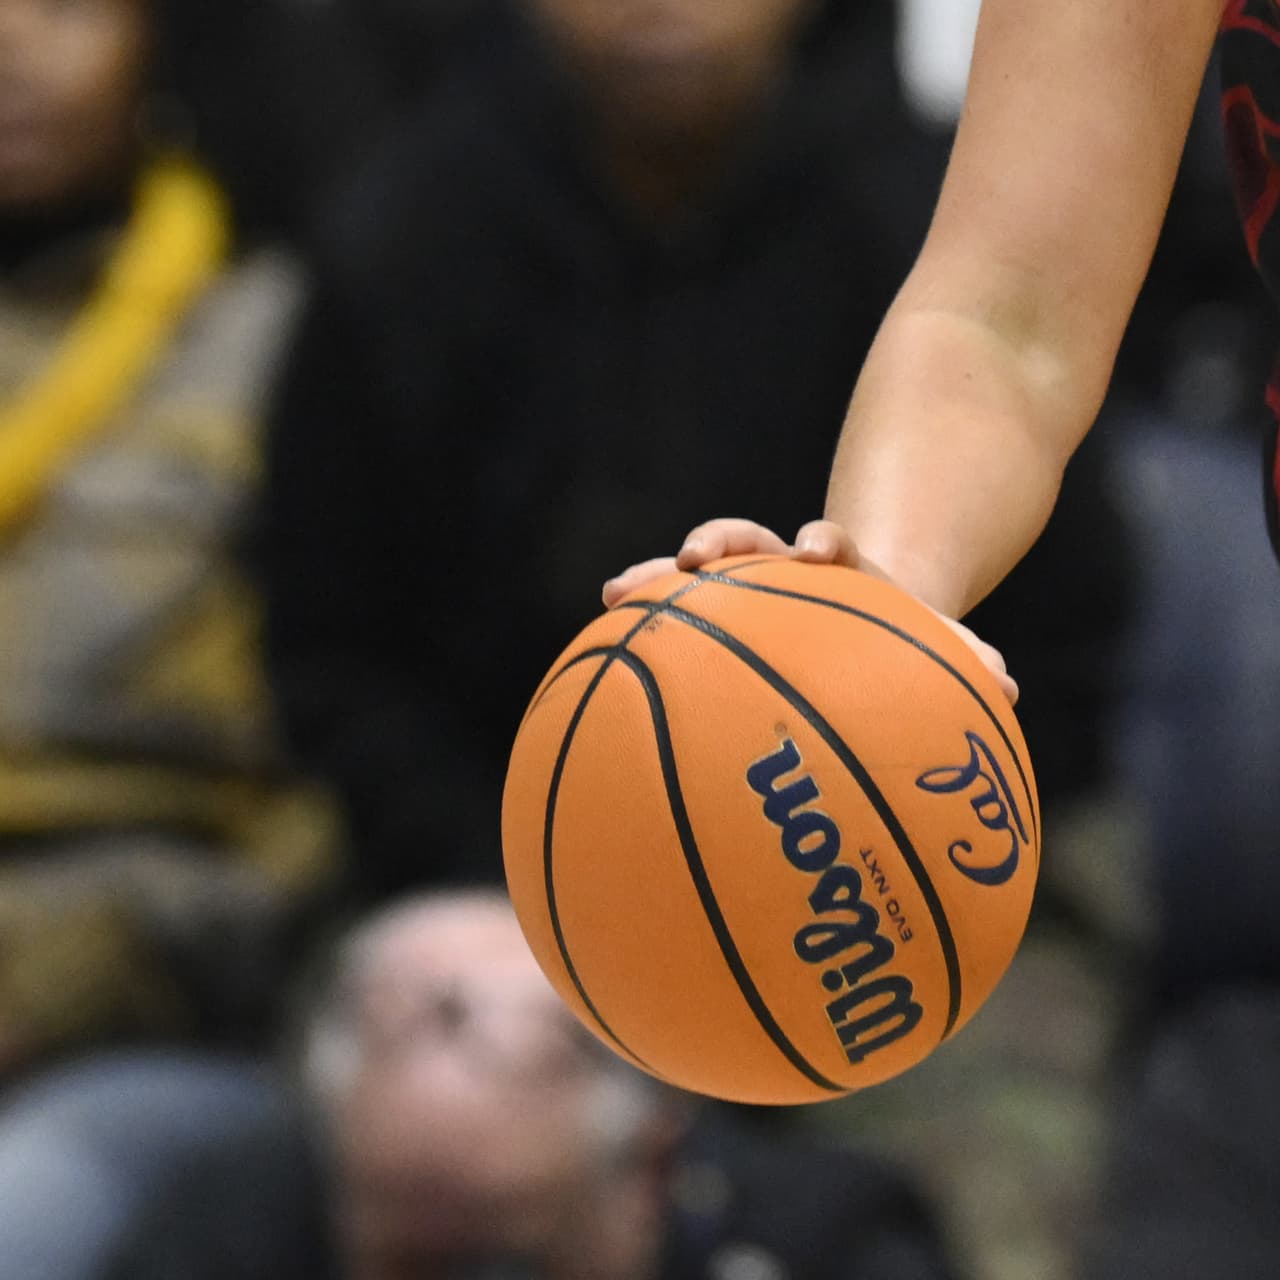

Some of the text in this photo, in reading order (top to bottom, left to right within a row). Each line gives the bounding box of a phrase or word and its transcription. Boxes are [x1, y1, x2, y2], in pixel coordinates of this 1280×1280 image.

[914, 730, 1030, 887] Cal
[745, 737, 924, 1064] Wilson
[859, 848, 913, 943] EVO NXT
